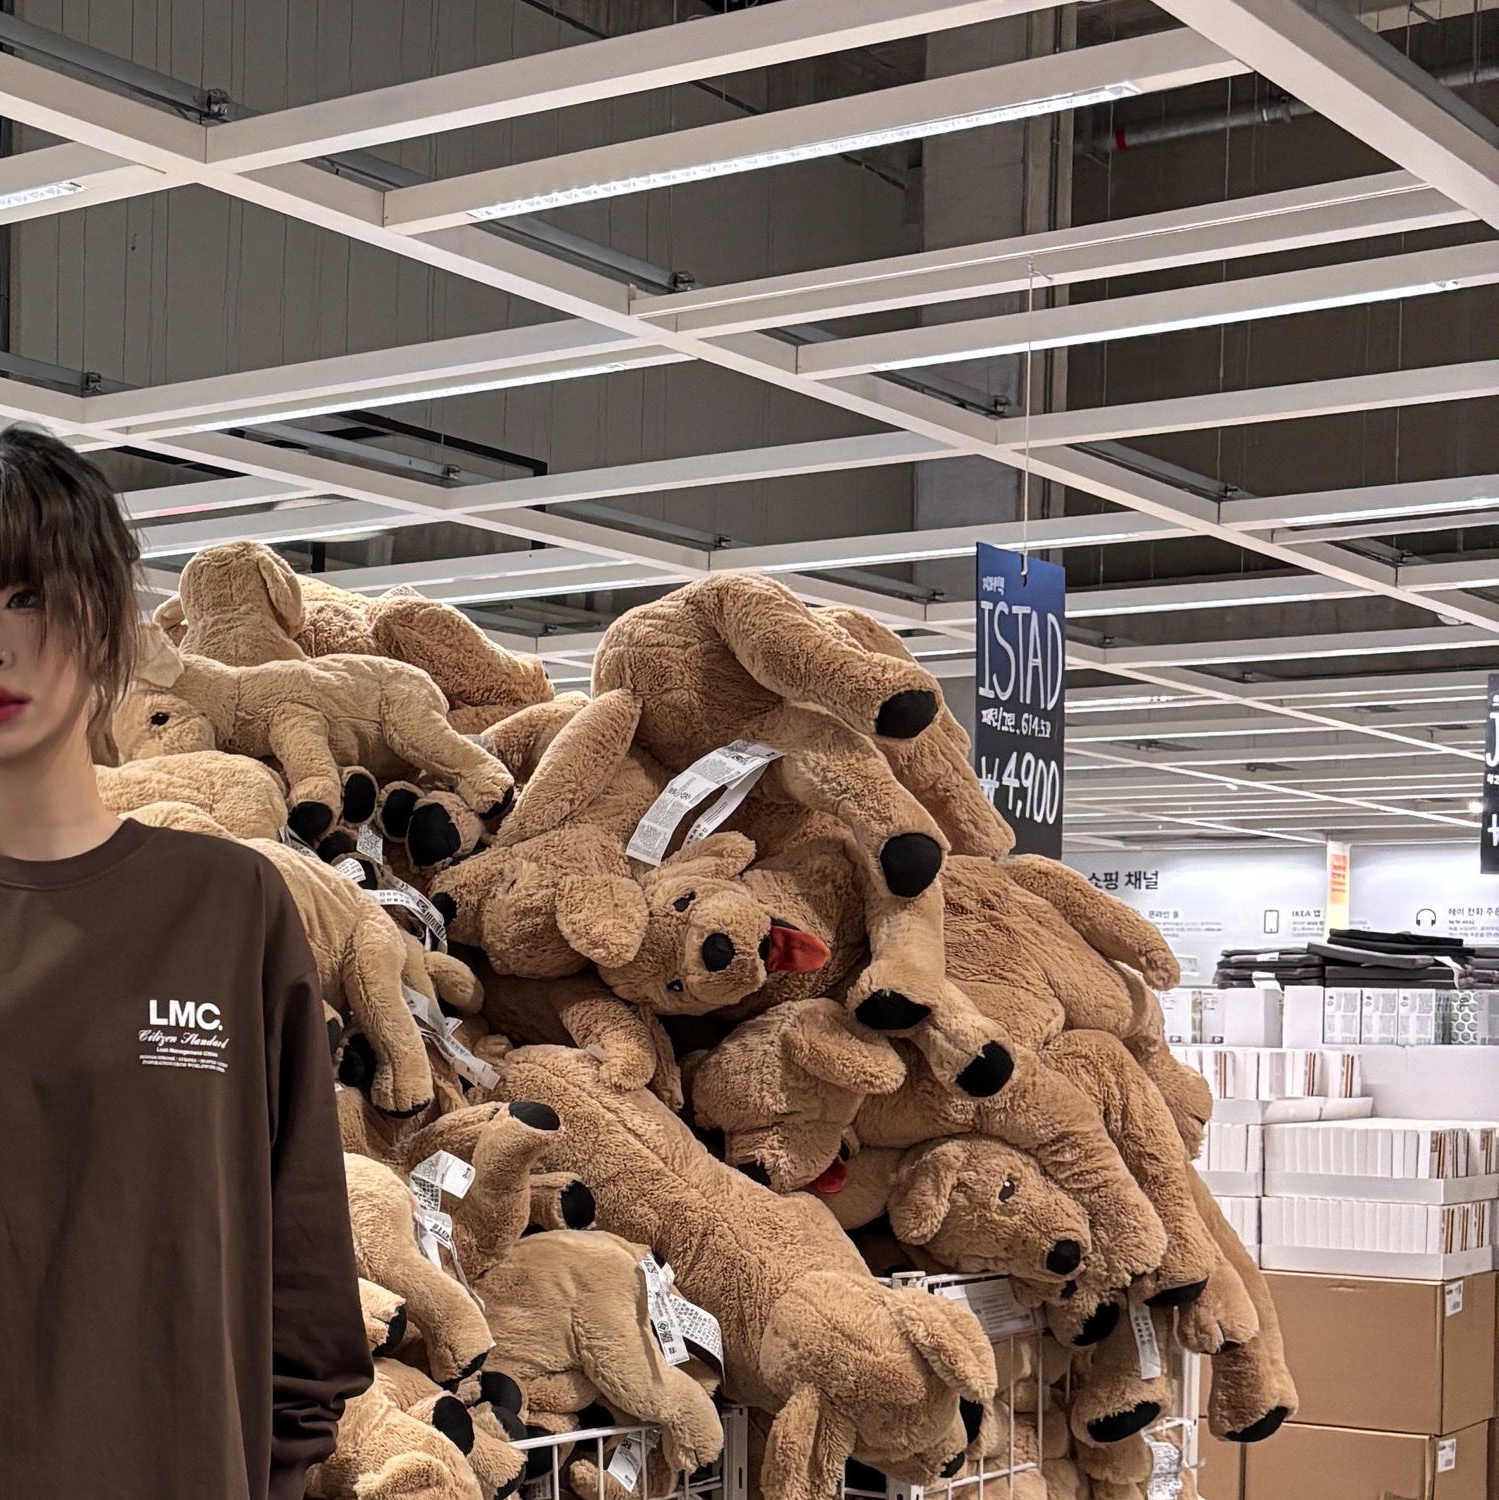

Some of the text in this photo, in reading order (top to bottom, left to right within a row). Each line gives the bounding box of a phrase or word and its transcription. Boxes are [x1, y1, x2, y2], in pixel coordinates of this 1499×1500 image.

[978, 600, 1063, 711] ISTAD
[979, 751, 1060, 825] ₩4,900
[1125, 871, 1159, 890] 채널
[138, 1030, 177, 1046] Citizen
